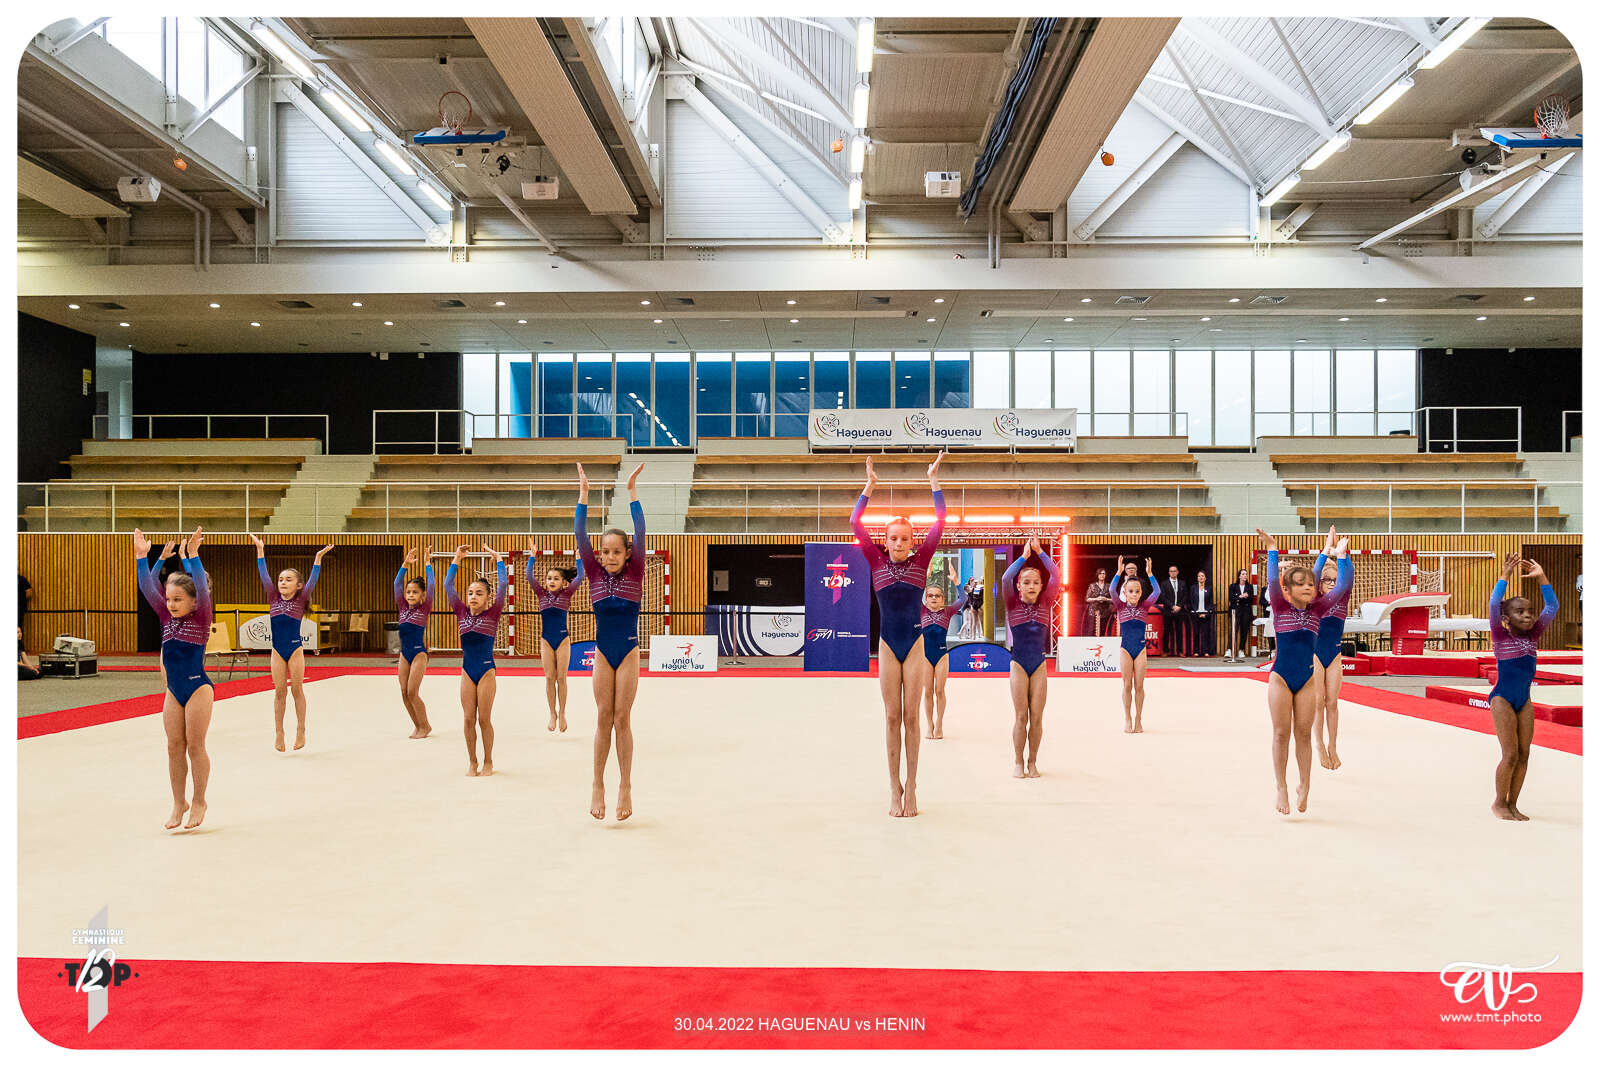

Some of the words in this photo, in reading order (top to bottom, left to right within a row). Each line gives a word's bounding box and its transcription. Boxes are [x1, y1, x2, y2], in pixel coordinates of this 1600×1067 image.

[836, 428, 892, 438] Haguenau
[925, 428, 982, 438] Haguenau
[1016, 428, 1071, 438] Haguenau
[823, 576, 852, 588] TOP
